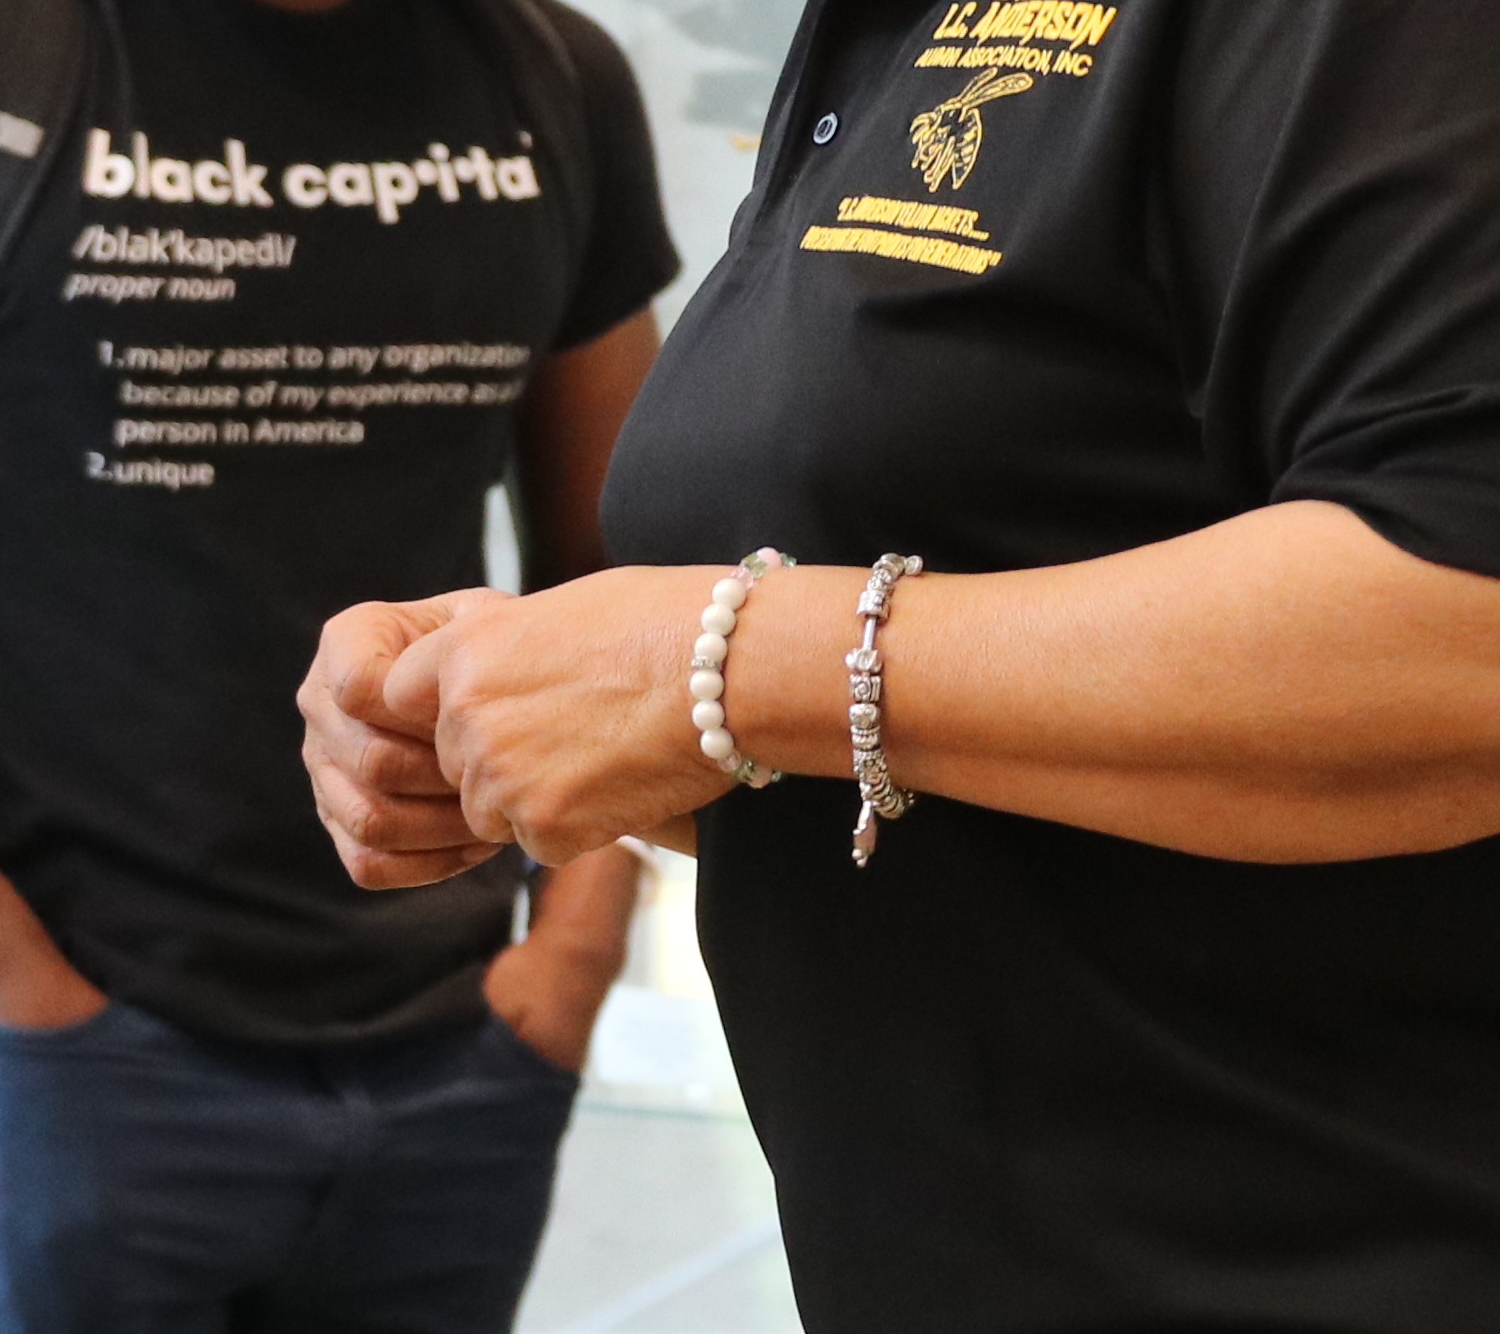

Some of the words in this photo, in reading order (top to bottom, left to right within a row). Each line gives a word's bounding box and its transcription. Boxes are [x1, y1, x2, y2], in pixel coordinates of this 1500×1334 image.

[968, 0, 1117, 51] ANDERSON
[81, 127, 274, 208] black
[64, 273, 165, 305] proper
[166, 277, 237, 302] noun
[124, 344, 215, 376] major
[219, 345, 290, 370] asset
[291, 344, 325, 370] to
[327, 345, 381, 376] any
[120, 380, 242, 408] because
[243, 379, 279, 409] of
[277, 384, 326, 412] my
[326, 380, 471, 411] experience
[114, 420, 218, 449] person
[221, 420, 251, 445] in
[250, 418, 366, 446] America
[112, 459, 216, 492] unique
